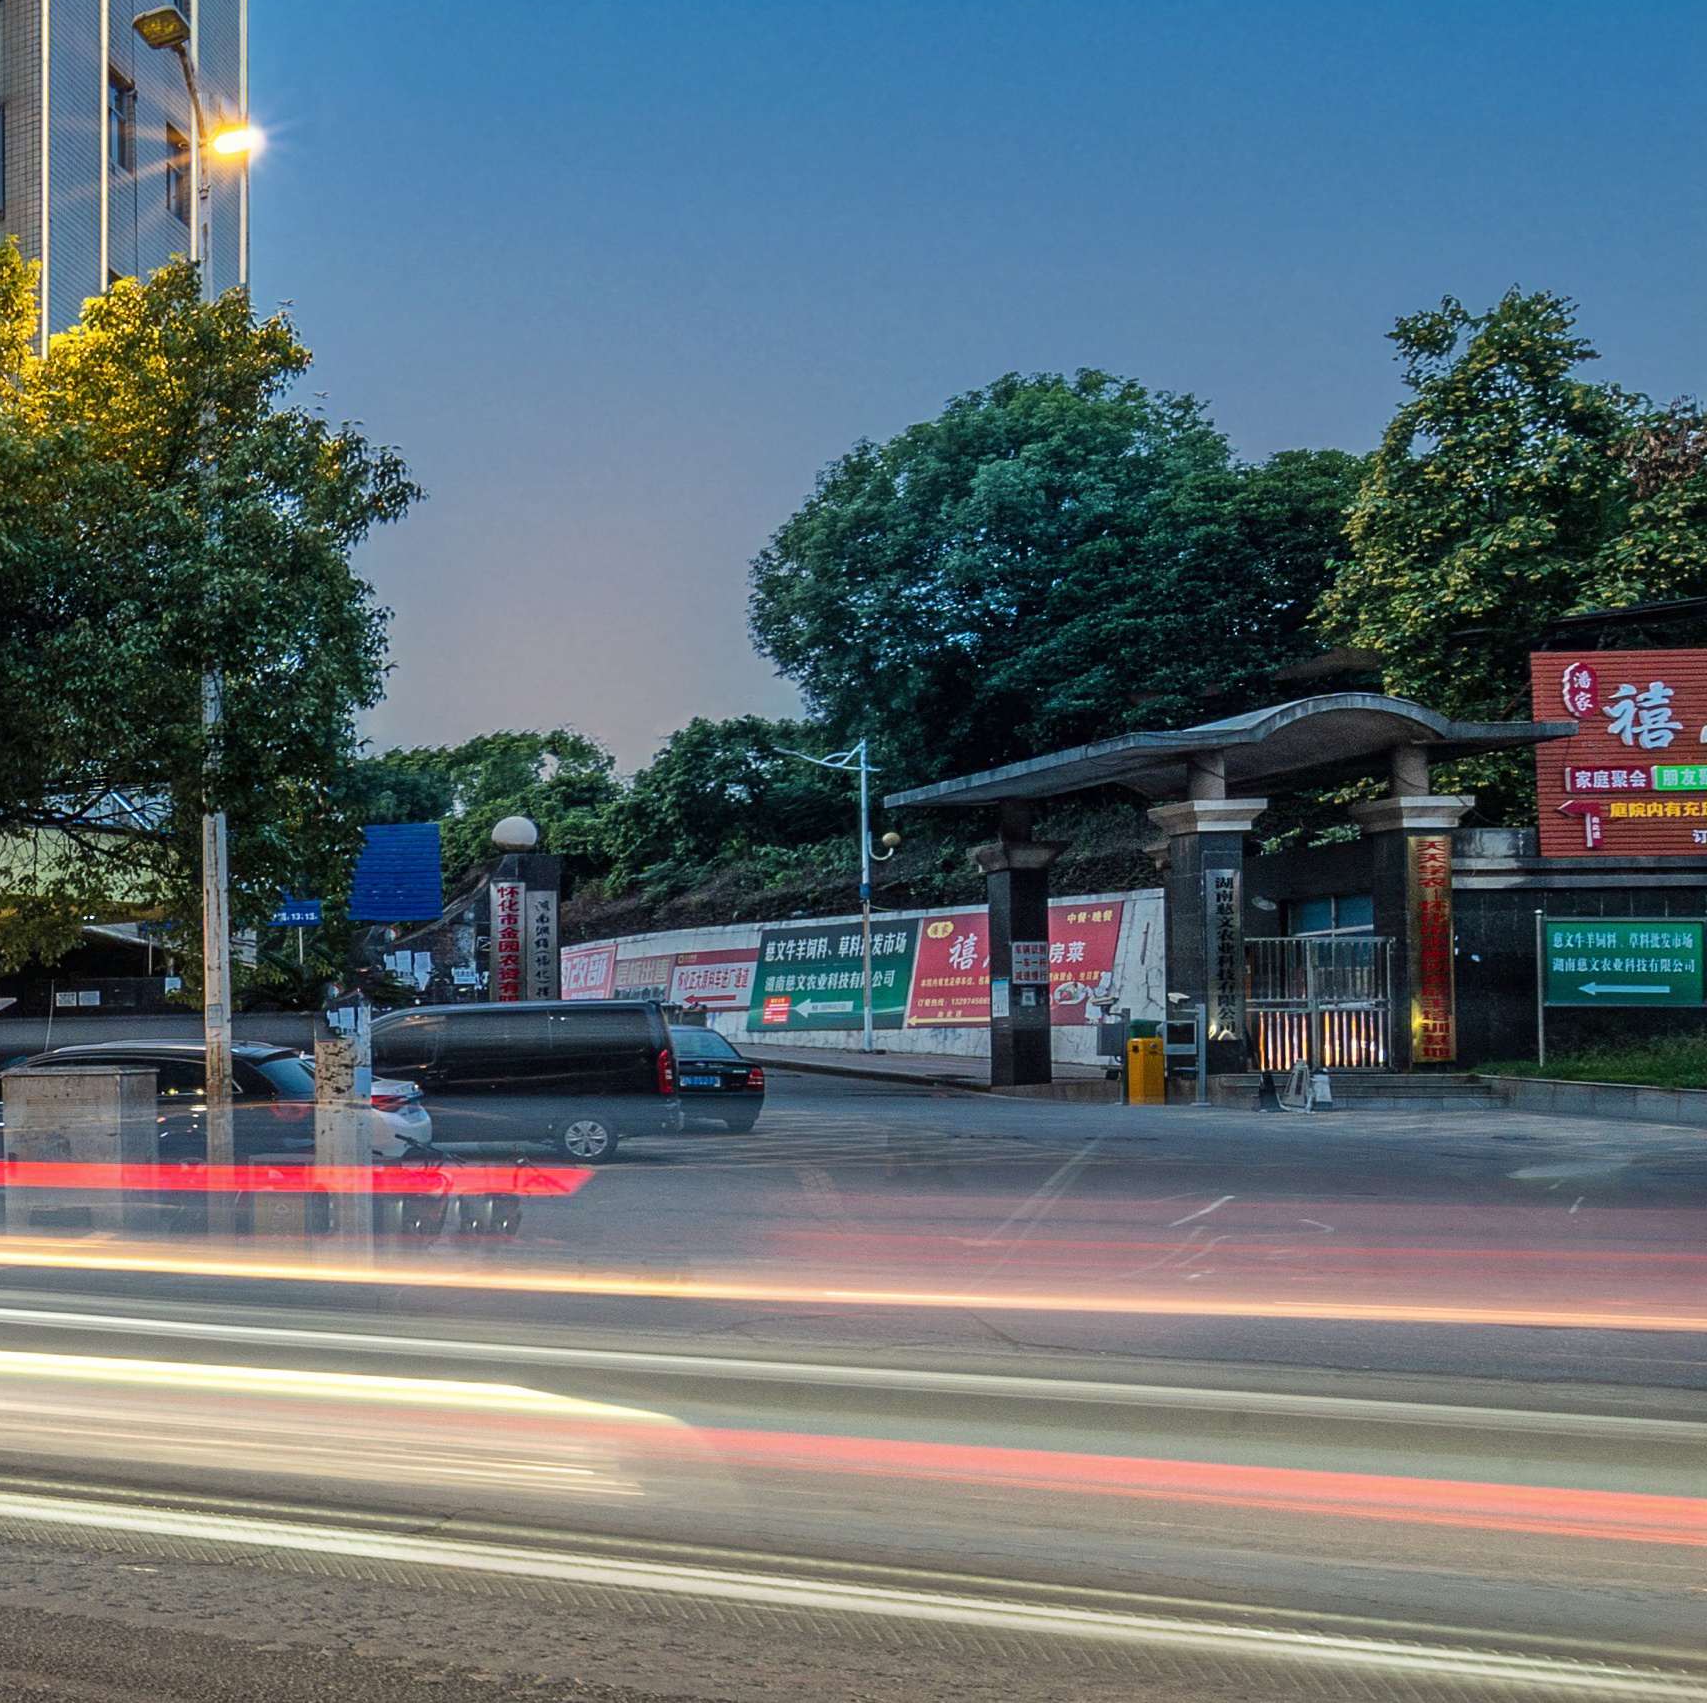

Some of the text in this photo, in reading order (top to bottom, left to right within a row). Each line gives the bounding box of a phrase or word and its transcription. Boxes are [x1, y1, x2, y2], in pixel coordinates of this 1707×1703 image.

[1573, 671, 1594, 712] 潘家
[1602, 681, 1707, 749] 禧
[1575, 770, 1647, 789] 家庭聚会
